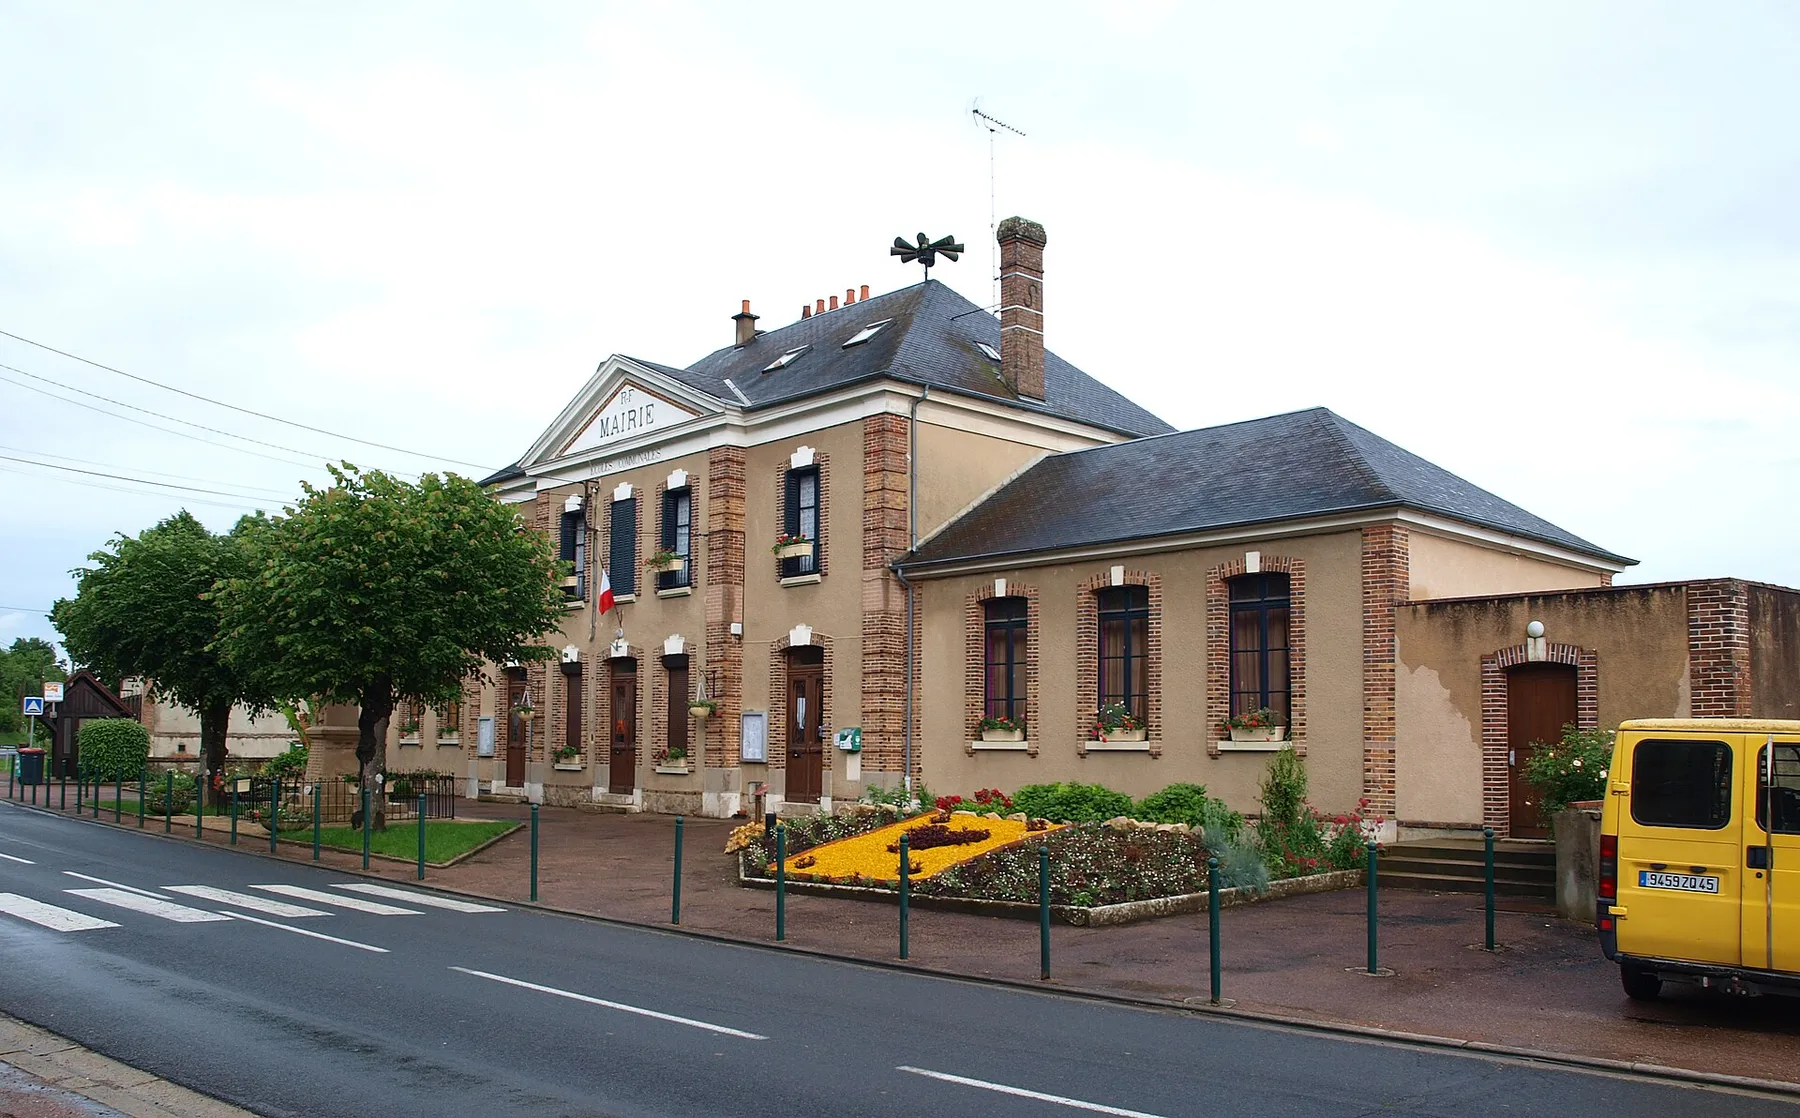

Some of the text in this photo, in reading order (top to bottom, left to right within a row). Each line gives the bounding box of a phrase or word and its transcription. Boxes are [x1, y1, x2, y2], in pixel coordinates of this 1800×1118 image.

[600, 403, 655, 439] MAIRIE
[1649, 873, 1714, 891] 9459 ZQ 45
